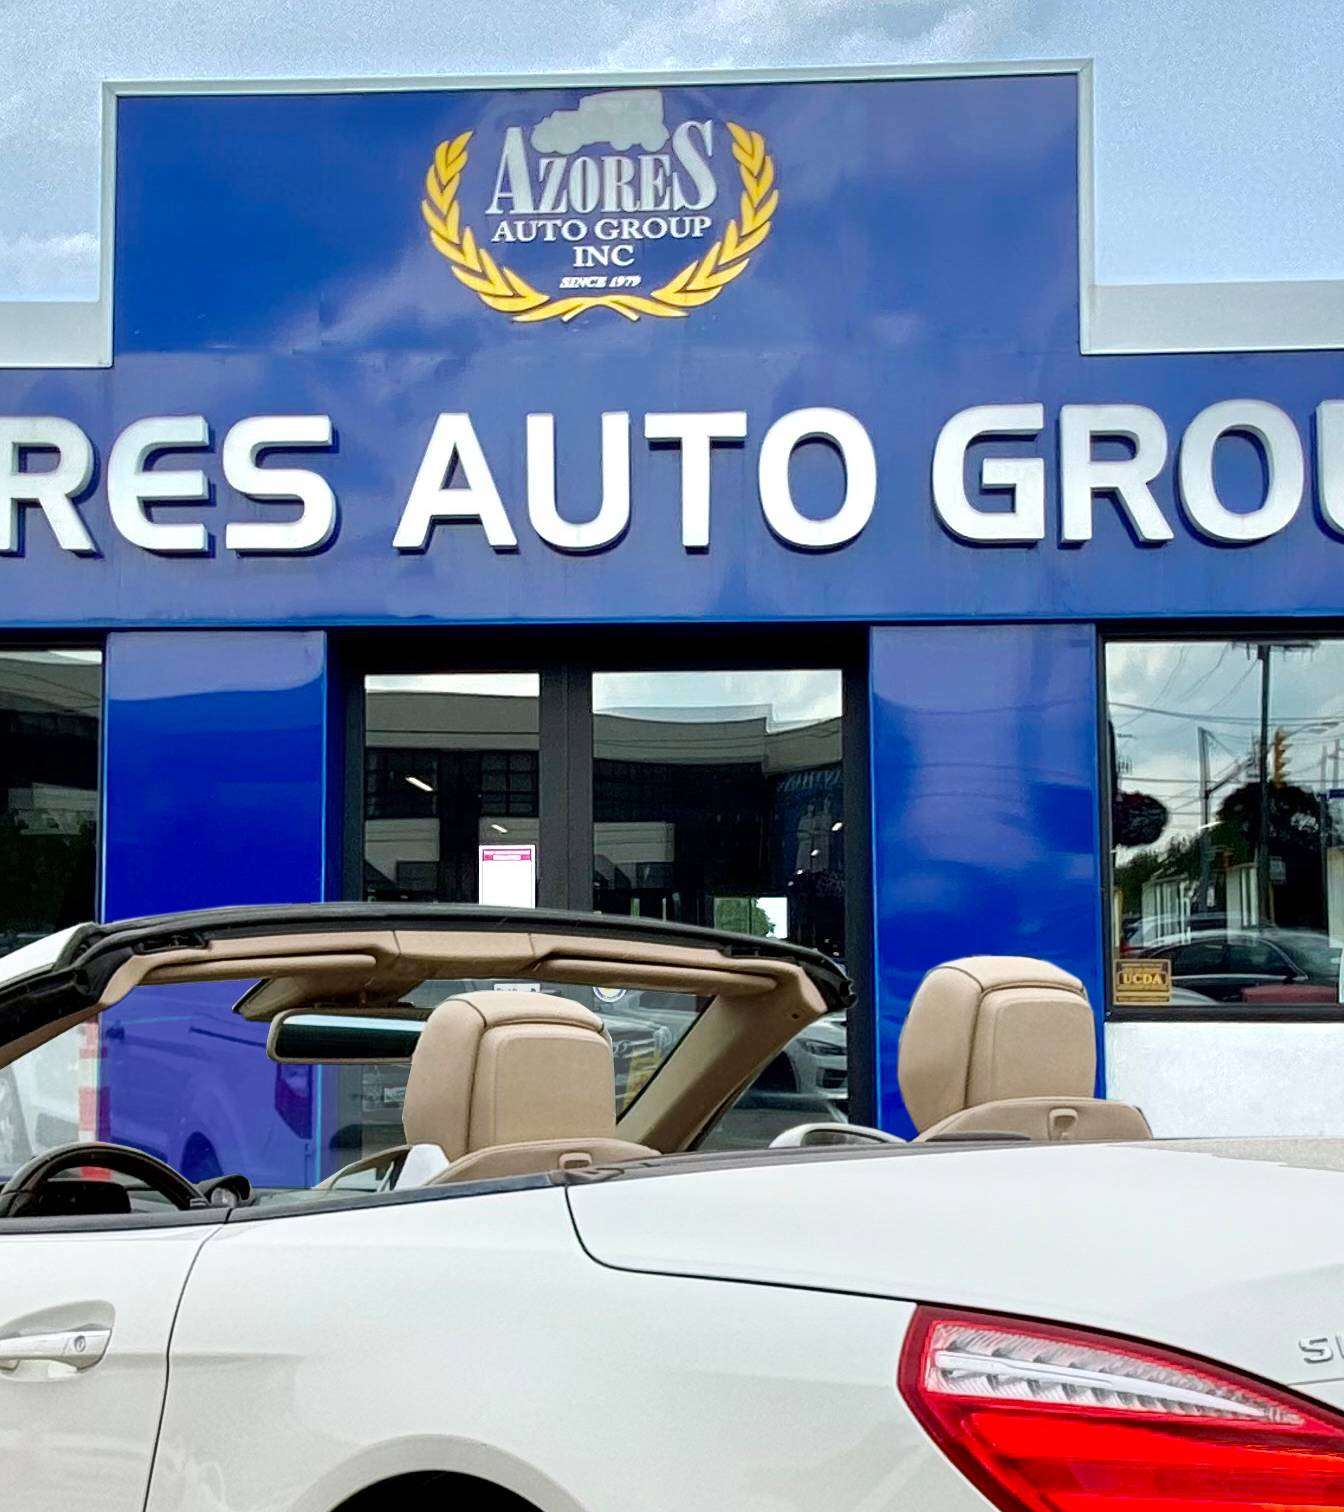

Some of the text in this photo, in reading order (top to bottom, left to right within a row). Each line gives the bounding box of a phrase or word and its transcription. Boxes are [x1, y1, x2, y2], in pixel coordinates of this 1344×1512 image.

[485, 120, 718, 216] AZORES
[491, 216, 712, 243] AUTO GROUP
[572, 245, 635, 268] INC
[559, 275, 641, 289] SINCE 1979
[392, 406, 878, 554] AUTO
[1123, 973, 1162, 985] UCDA
